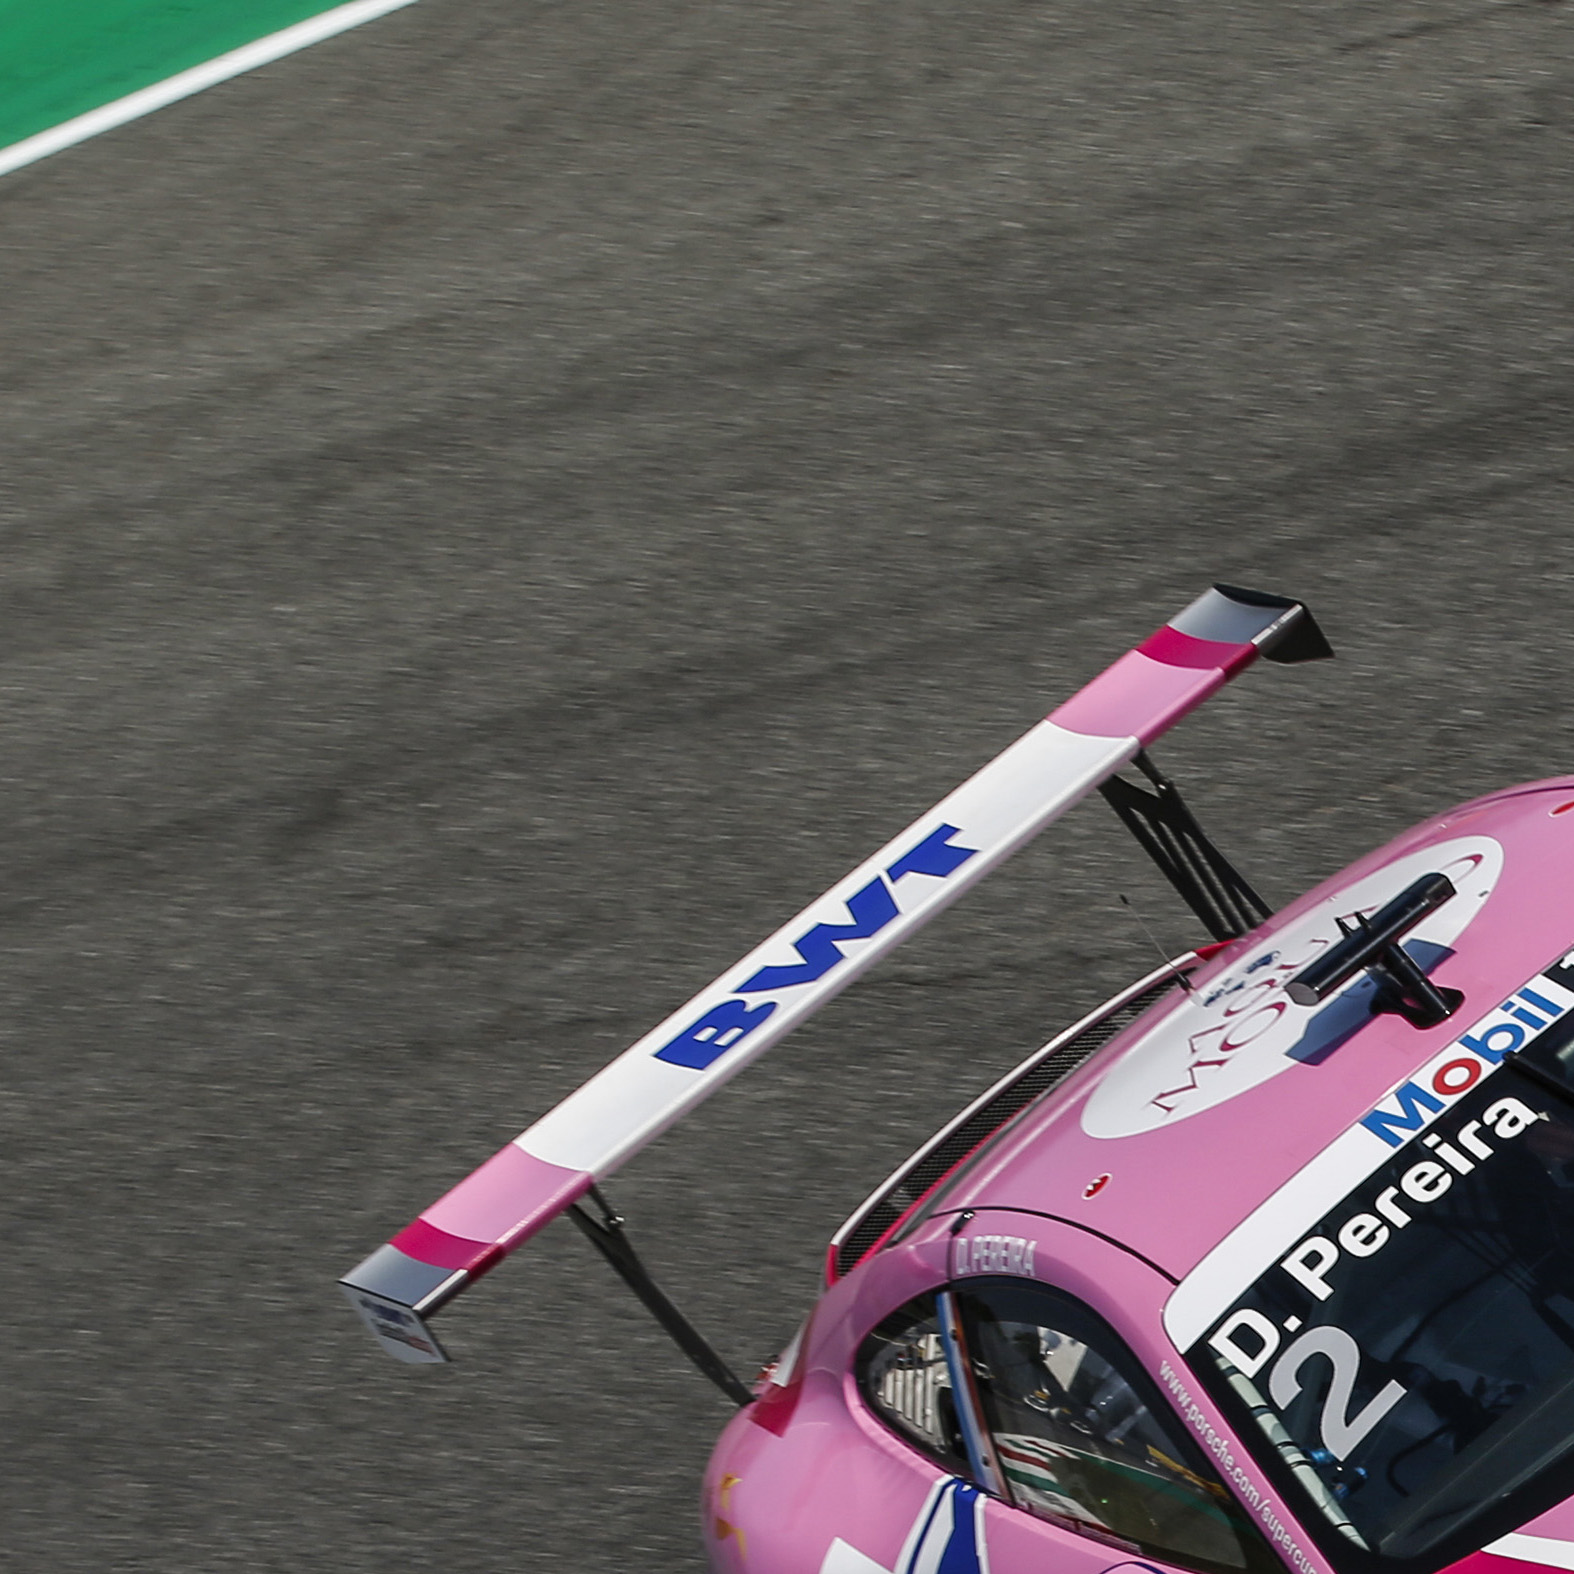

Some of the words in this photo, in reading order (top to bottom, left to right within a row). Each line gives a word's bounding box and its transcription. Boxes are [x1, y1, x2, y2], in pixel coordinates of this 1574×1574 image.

[654, 823, 979, 1070] BWT
[1359, 988, 1564, 1148] Mobil
[1208, 1308, 1303, 1379] D.
[1279, 1096, 1540, 1301] Pereira
[1268, 1325, 1408, 1462] 2
